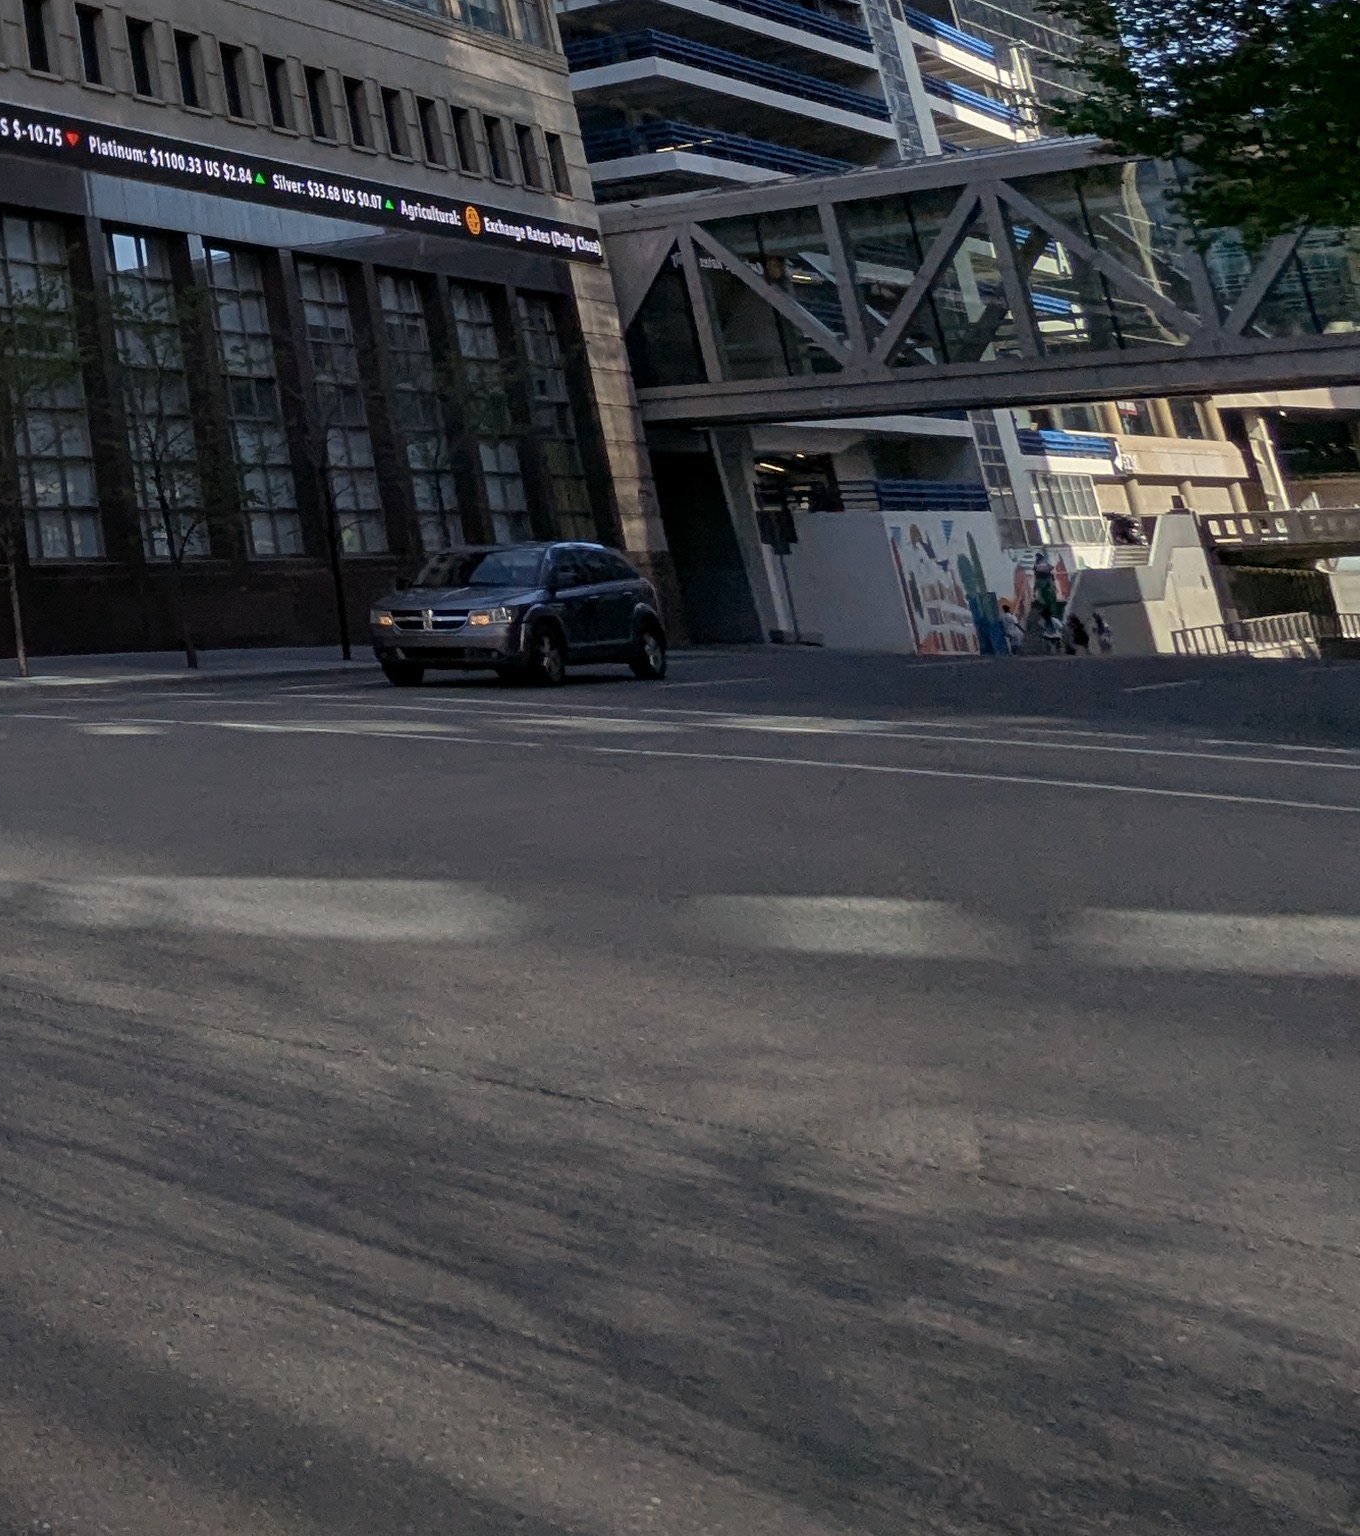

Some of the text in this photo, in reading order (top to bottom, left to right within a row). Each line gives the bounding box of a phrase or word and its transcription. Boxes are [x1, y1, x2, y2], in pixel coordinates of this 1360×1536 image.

[13, 119, 62, 147] $-10.75
[88, 135, 147, 163] Platinum:
[150, 147, 202, 174] $1100.33
[205, 159, 220, 178] US
[223, 162, 252, 184] $2.84
[272, 174, 306, 195] Silver:
[307, 180, 341, 202] $33.68
[342, 188, 355, 205] US
[358, 190, 382, 210] $0.07
[400, 200, 462, 226] Agricultural:
[484, 217, 526, 242] Exchange
[527, 226, 551, 244] Rates
[552, 230, 576, 253] (Daily
